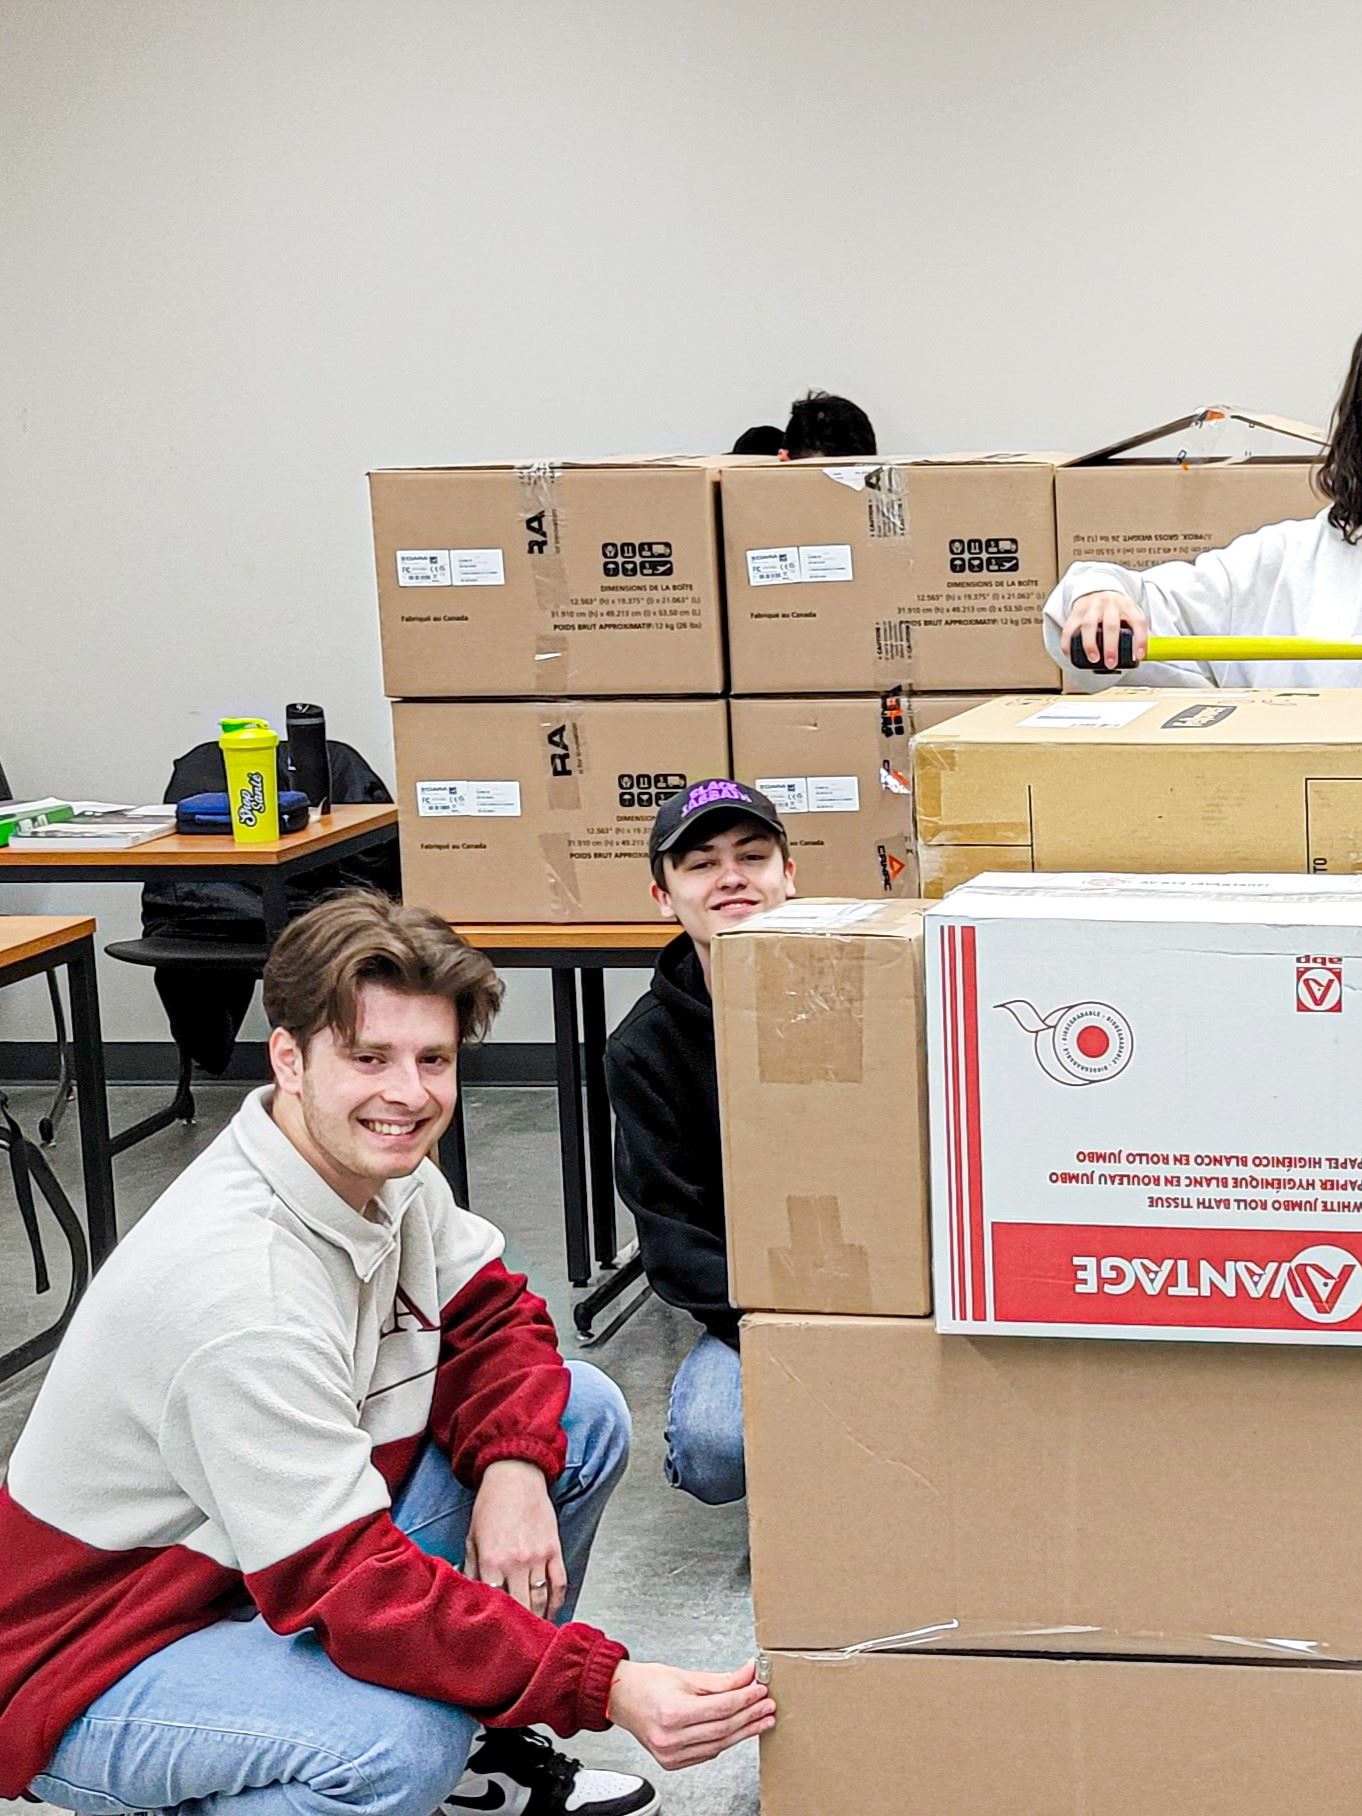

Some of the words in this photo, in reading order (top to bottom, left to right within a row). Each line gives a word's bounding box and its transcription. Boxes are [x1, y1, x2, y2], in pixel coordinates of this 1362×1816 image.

[547, 724, 573, 777] RA
[1313, 857, 1328, 874] TO
[1296, 954, 1342, 966] abp
[1076, 1149, 1122, 1164] JUMBO
[1125, 1152, 1169, 1165] ROLLO
[1172, 1153, 1190, 1165] EN
[1193, 1153, 1248, 1167] BLANCO
[1251, 1155, 1322, 1172] HIGIÉNICO
[1048, 1170, 1096, 1186] JUMBO
[1097, 1173, 1161, 1187] ROULEAU
[1163, 1174, 1181, 1188] EN
[1184, 1175, 1229, 1189] BLANC
[1231, 1174, 1316, 1194] HYGIÉNIQUE
[1146, 1195, 1193, 1209] TISSUE
[1196, 1197, 1231, 1210] BATH
[1232, 1198, 1268, 1211] ROLL
[1271, 1197, 1319, 1213] JUMBO
[1072, 1255, 1357, 1315] AVANTAGE
